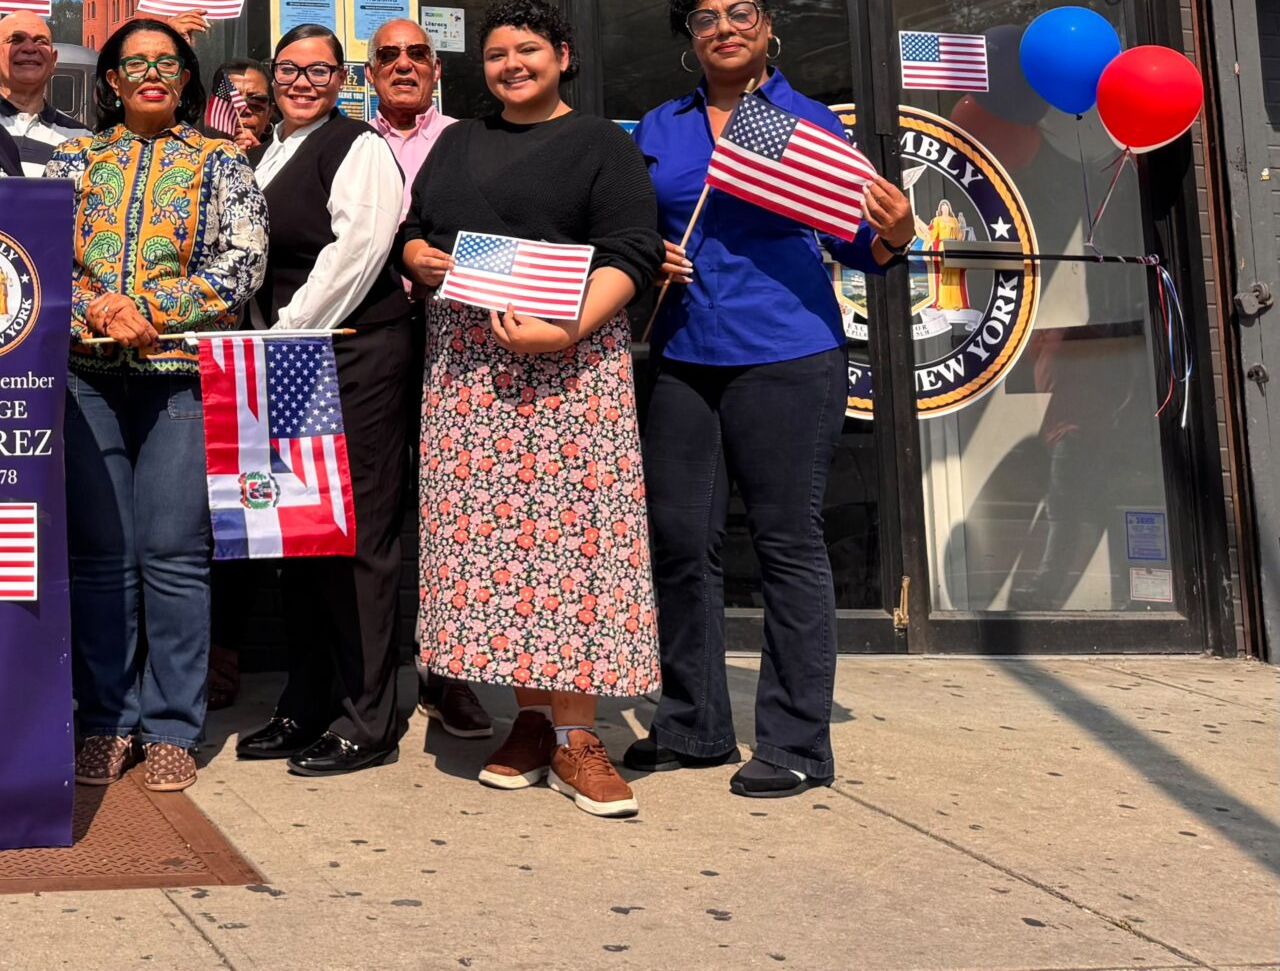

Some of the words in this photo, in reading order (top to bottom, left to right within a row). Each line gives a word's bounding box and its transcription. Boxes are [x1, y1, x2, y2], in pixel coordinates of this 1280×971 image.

[5, 297, 33, 337] YORK
[969, 274, 1018, 361] YORK
[0, 469, 18, 485] 78
